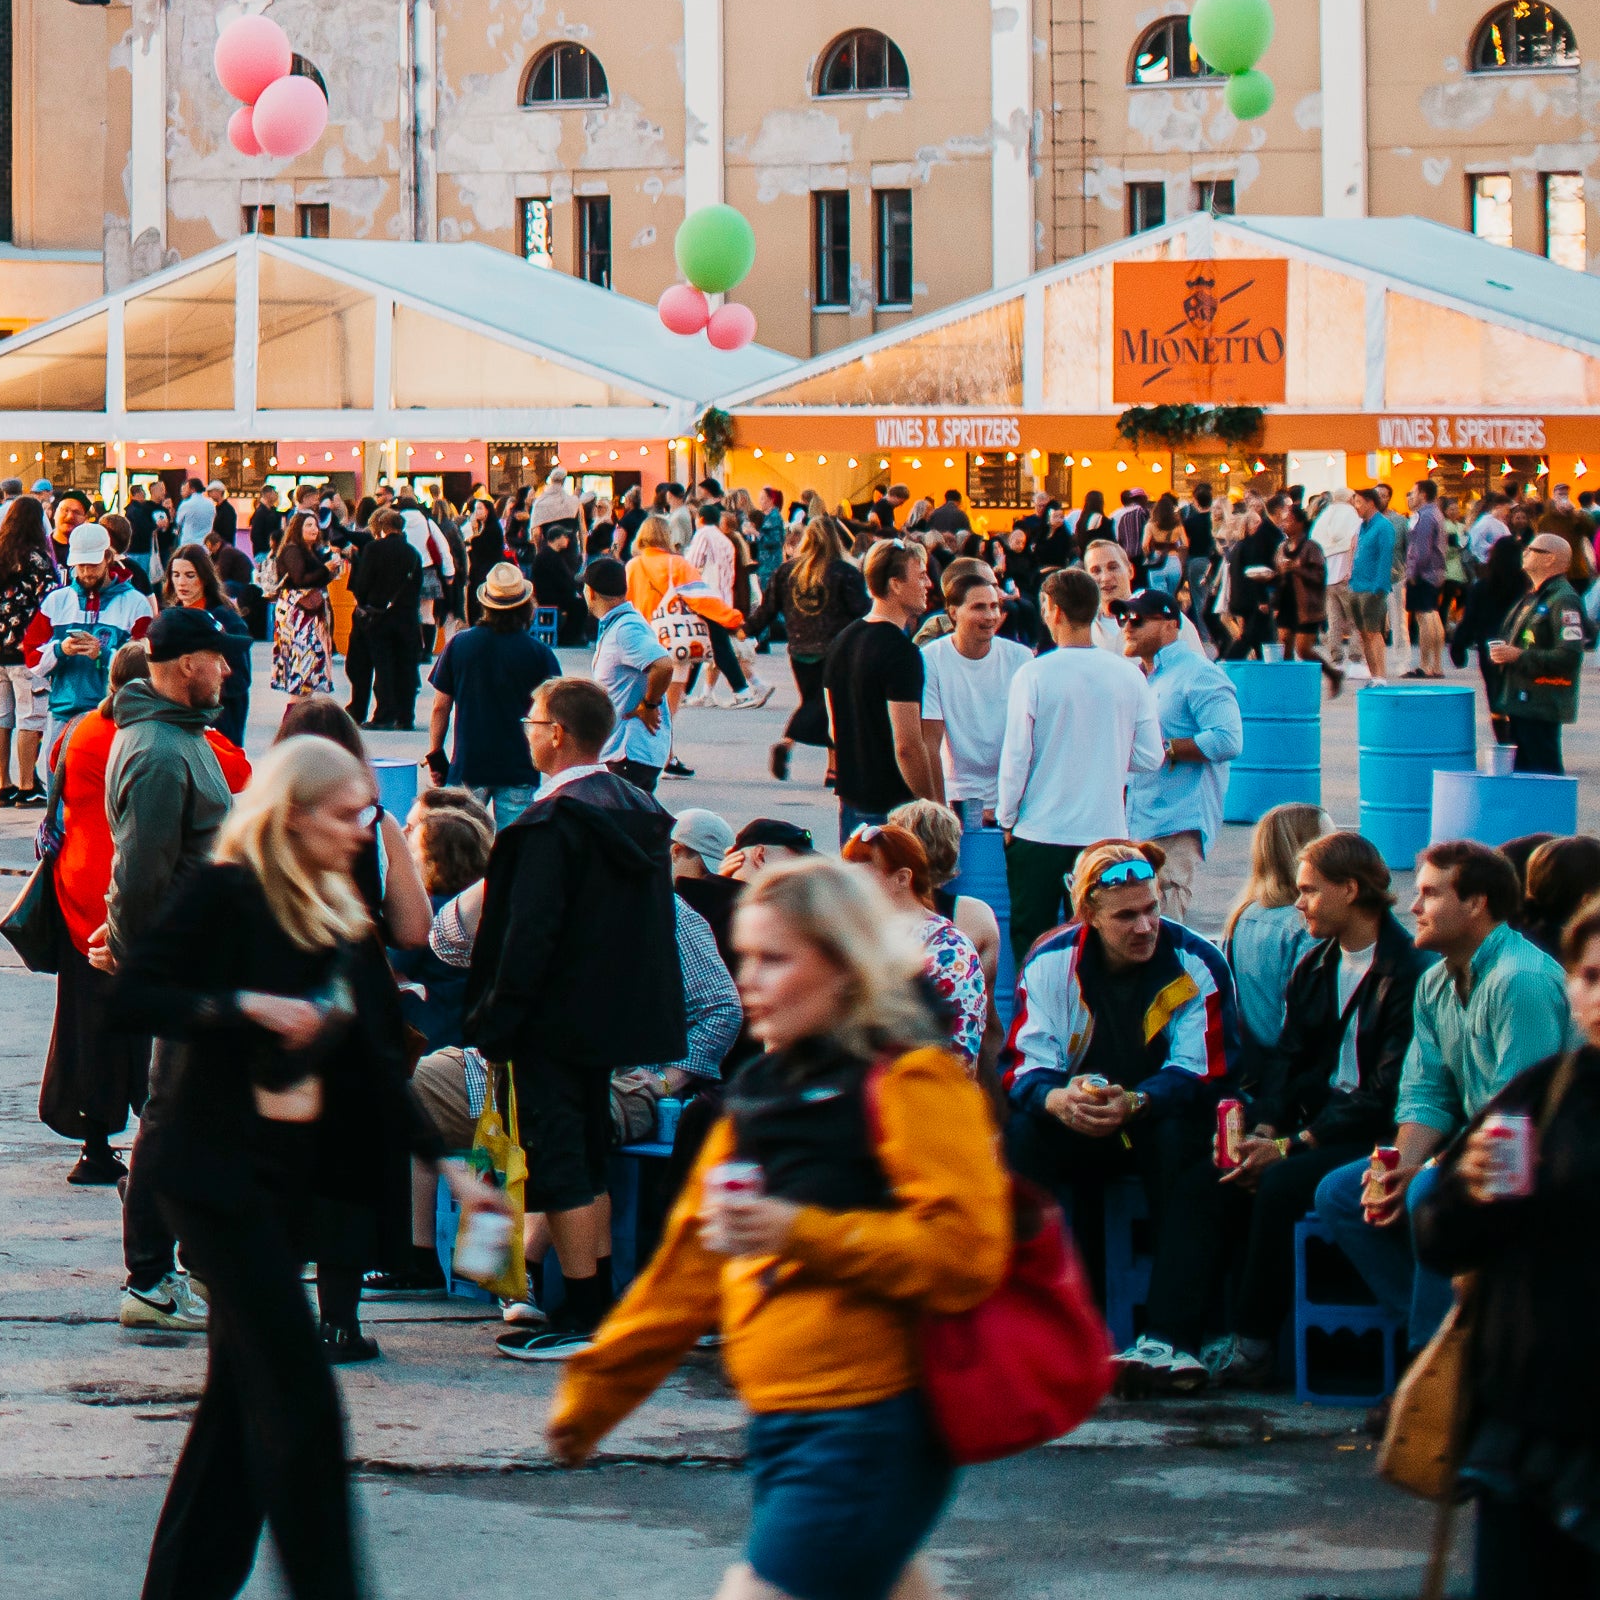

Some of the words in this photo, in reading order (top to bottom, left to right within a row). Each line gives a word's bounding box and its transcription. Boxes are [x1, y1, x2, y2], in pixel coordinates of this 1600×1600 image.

[876, 418, 924, 447] WINES
[926, 418, 939, 447] &
[942, 418, 1021, 447] SPRITZERS
[1379, 417, 1435, 448] WINES
[1437, 417, 1453, 448] &
[1455, 418, 1547, 449] SPRITZERS
